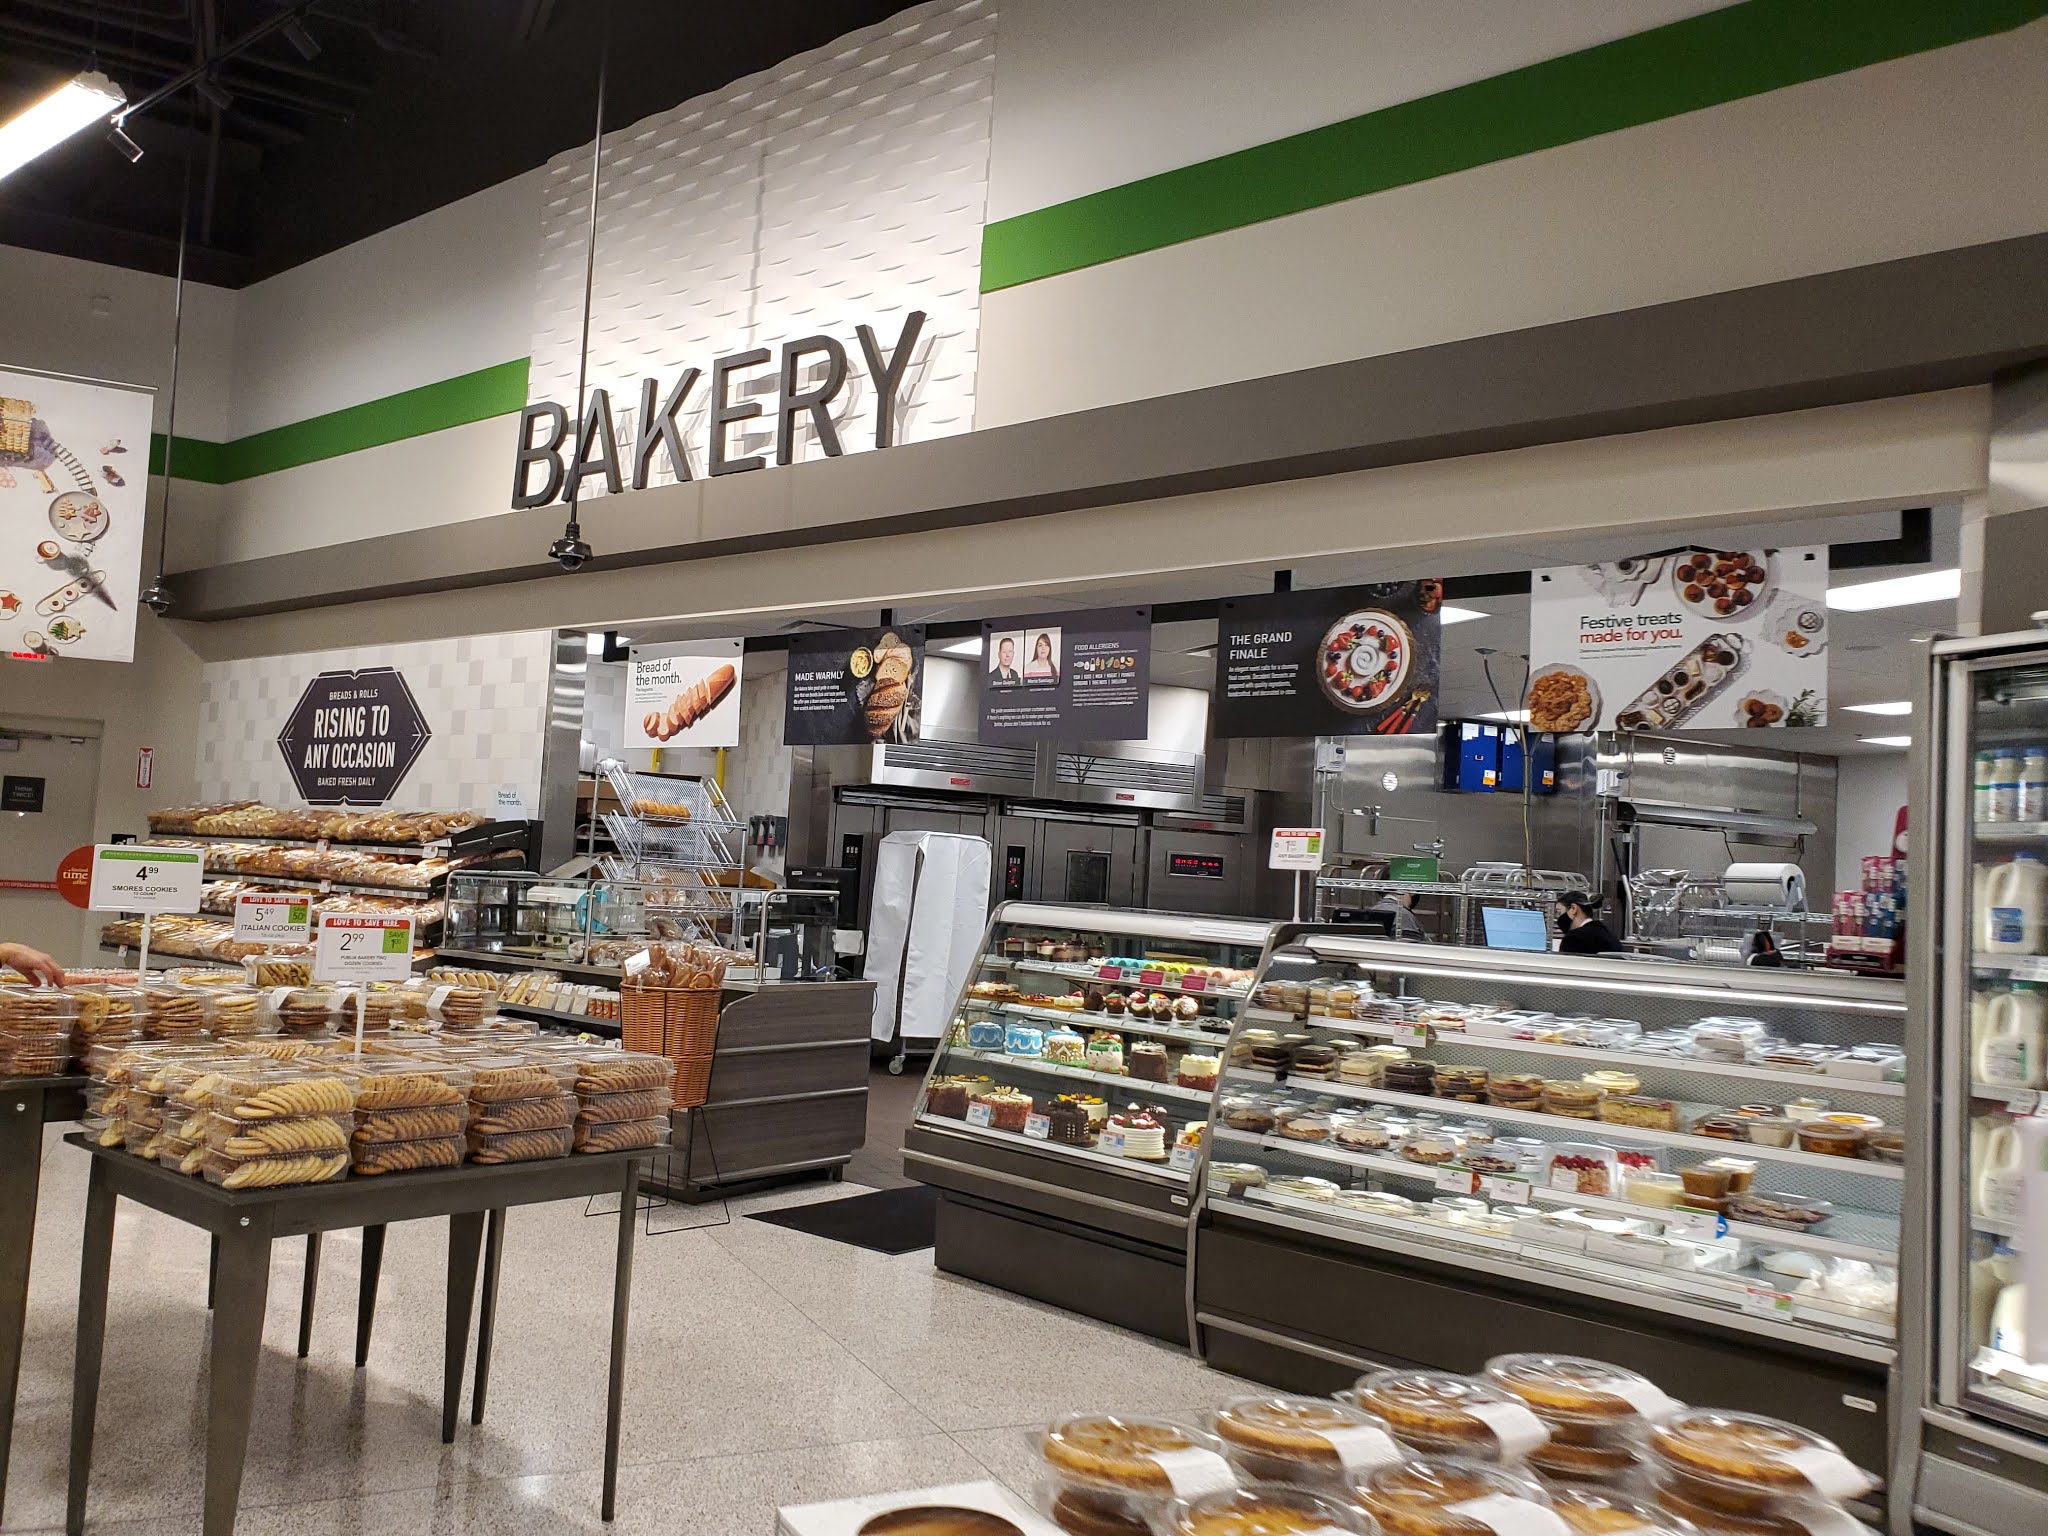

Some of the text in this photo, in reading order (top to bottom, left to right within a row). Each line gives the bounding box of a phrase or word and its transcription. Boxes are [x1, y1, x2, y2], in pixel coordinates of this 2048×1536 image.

[512, 311, 927, 509] BAKERY
[1580, 612, 1682, 630] Festive treats
[1230, 631, 1292, 646] THE GRAND
[1580, 627, 1683, 644] made for you.
[1230, 648, 1268, 660] FINALE
[636, 659, 671, 674] Bread of
[636, 672, 682, 686] the month.
[795, 671, 844, 681] MADE WARMLY
[329, 689, 378, 700] BREADS & ROLLS
[314, 704, 390, 738] RISING TO
[304, 742, 396, 768] ANY OCCASION
[317, 777, 376, 786] BAKED FRESH DAILY
[63, 870, 88, 880] time
[333, 918, 350, 926] LOVE
